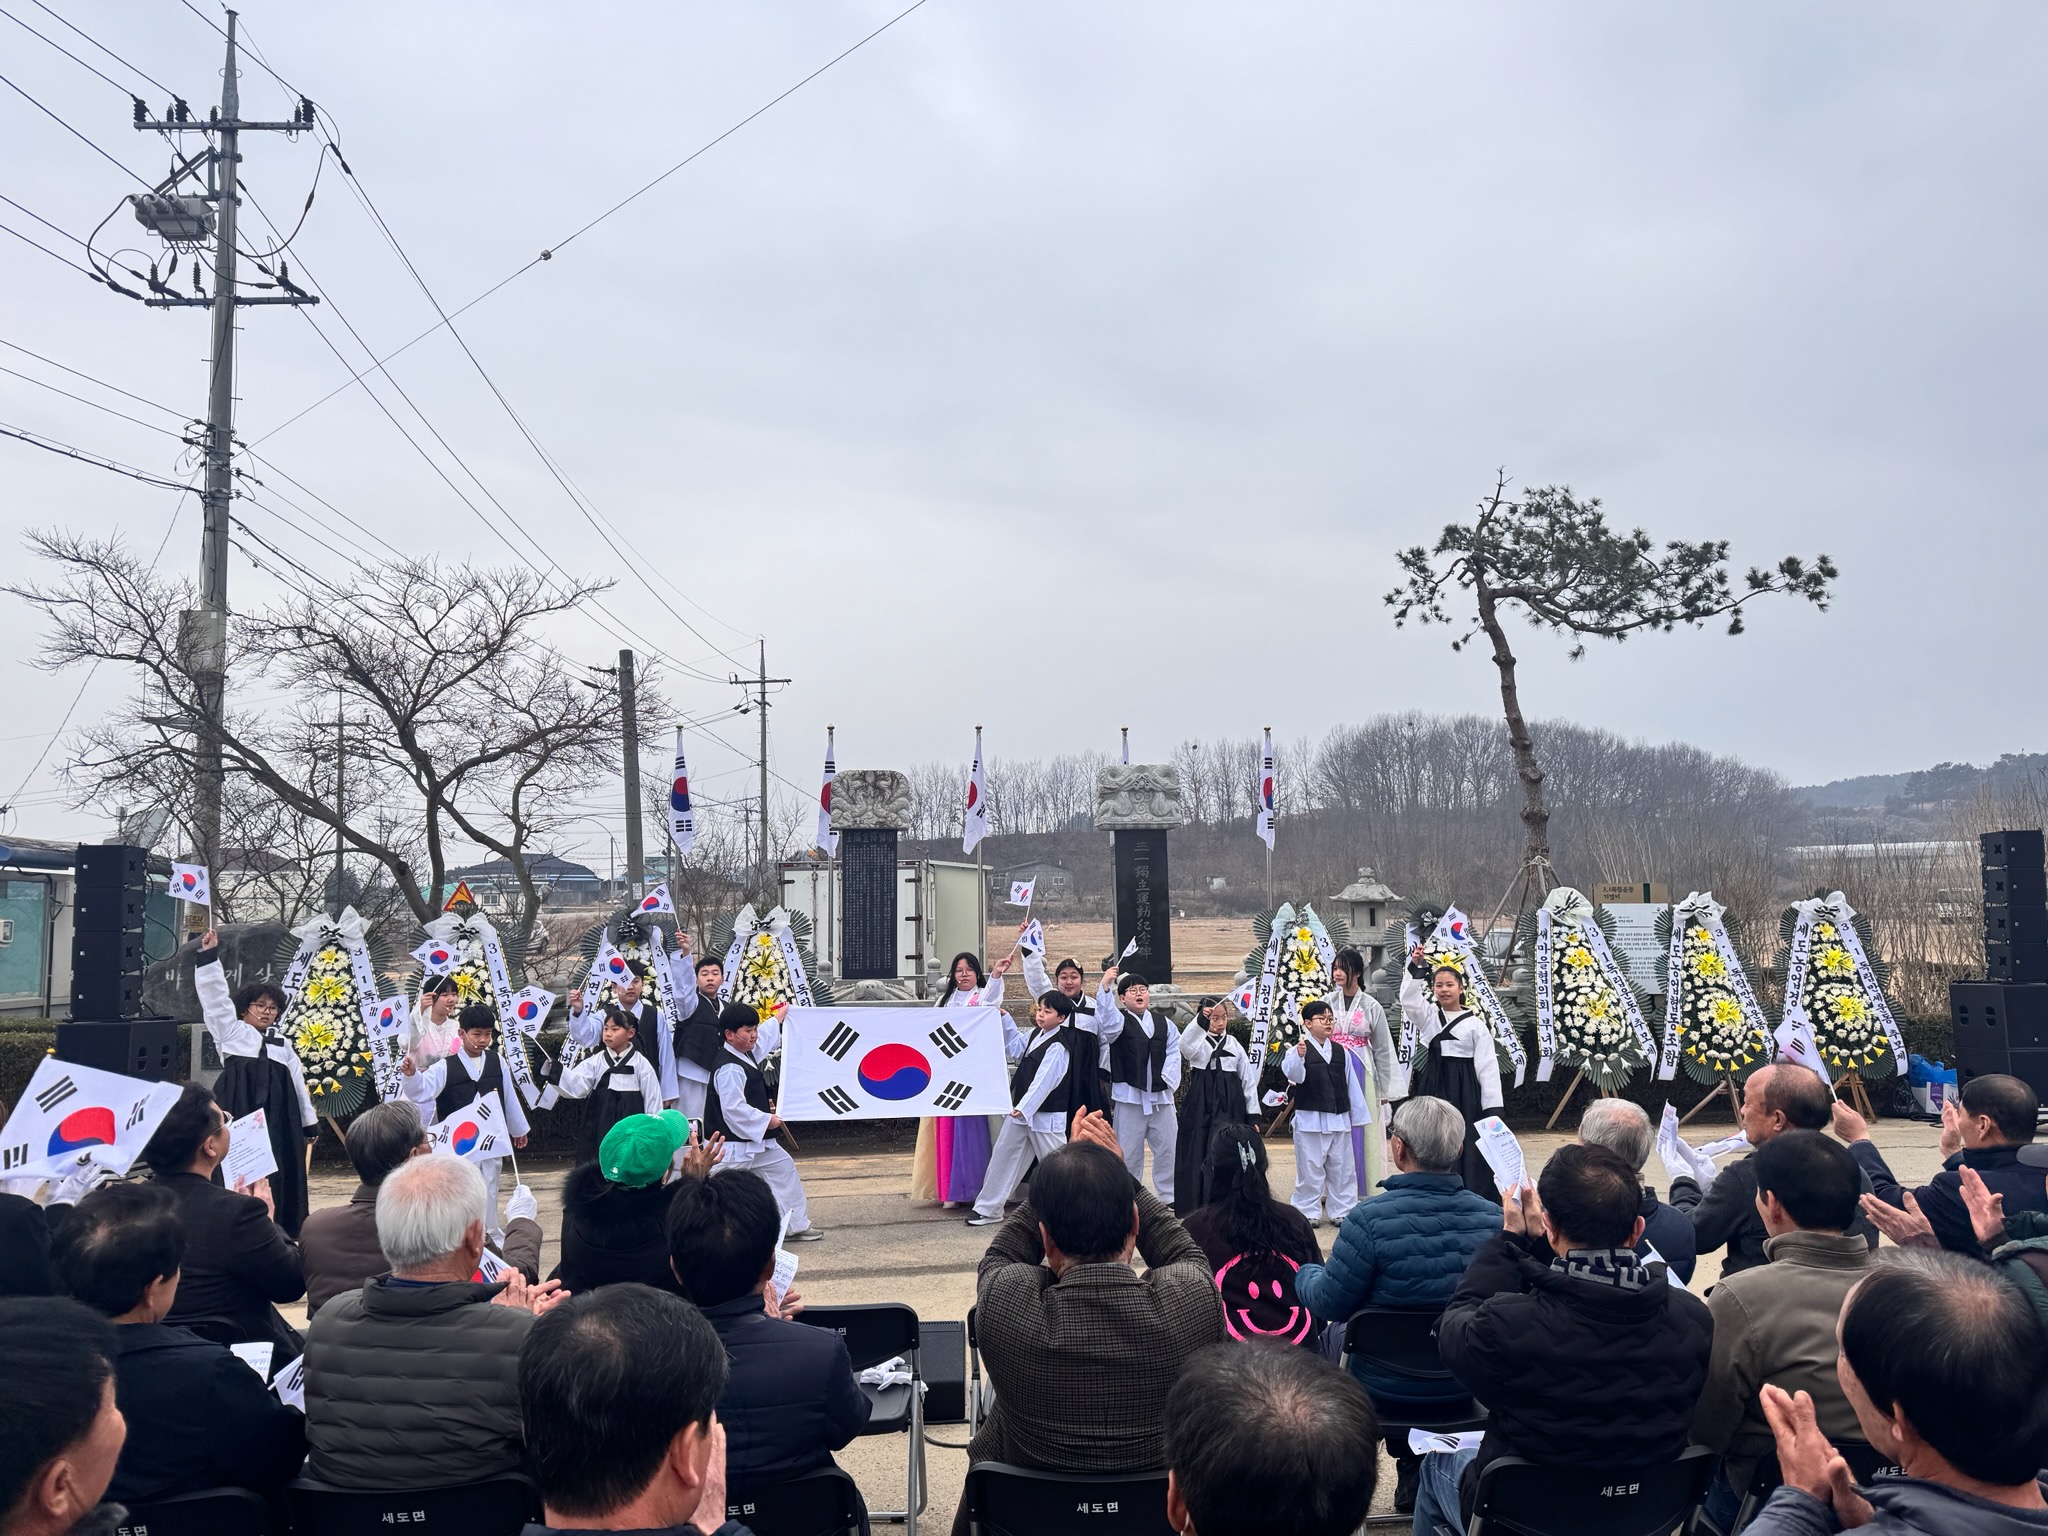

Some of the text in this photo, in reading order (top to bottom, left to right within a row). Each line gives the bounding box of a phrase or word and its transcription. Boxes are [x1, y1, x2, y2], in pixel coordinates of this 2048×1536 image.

[1664, 926, 1682, 1068] 세도농업협동조합
[1502, 1027, 1526, 1067] 추모제
[1538, 1018, 1554, 1060] 부녀회
[1634, 1017, 1656, 1057] 추모제
[1888, 1028, 1906, 1062] 추모제
[509, 1046, 531, 1086] 추모제
[1076, 1501, 1119, 1514] 세도면
[1600, 1482, 1640, 1498] 세도면
[381, 1509, 426, 1524] 세도면
[727, 1502, 756, 1516] 도면
